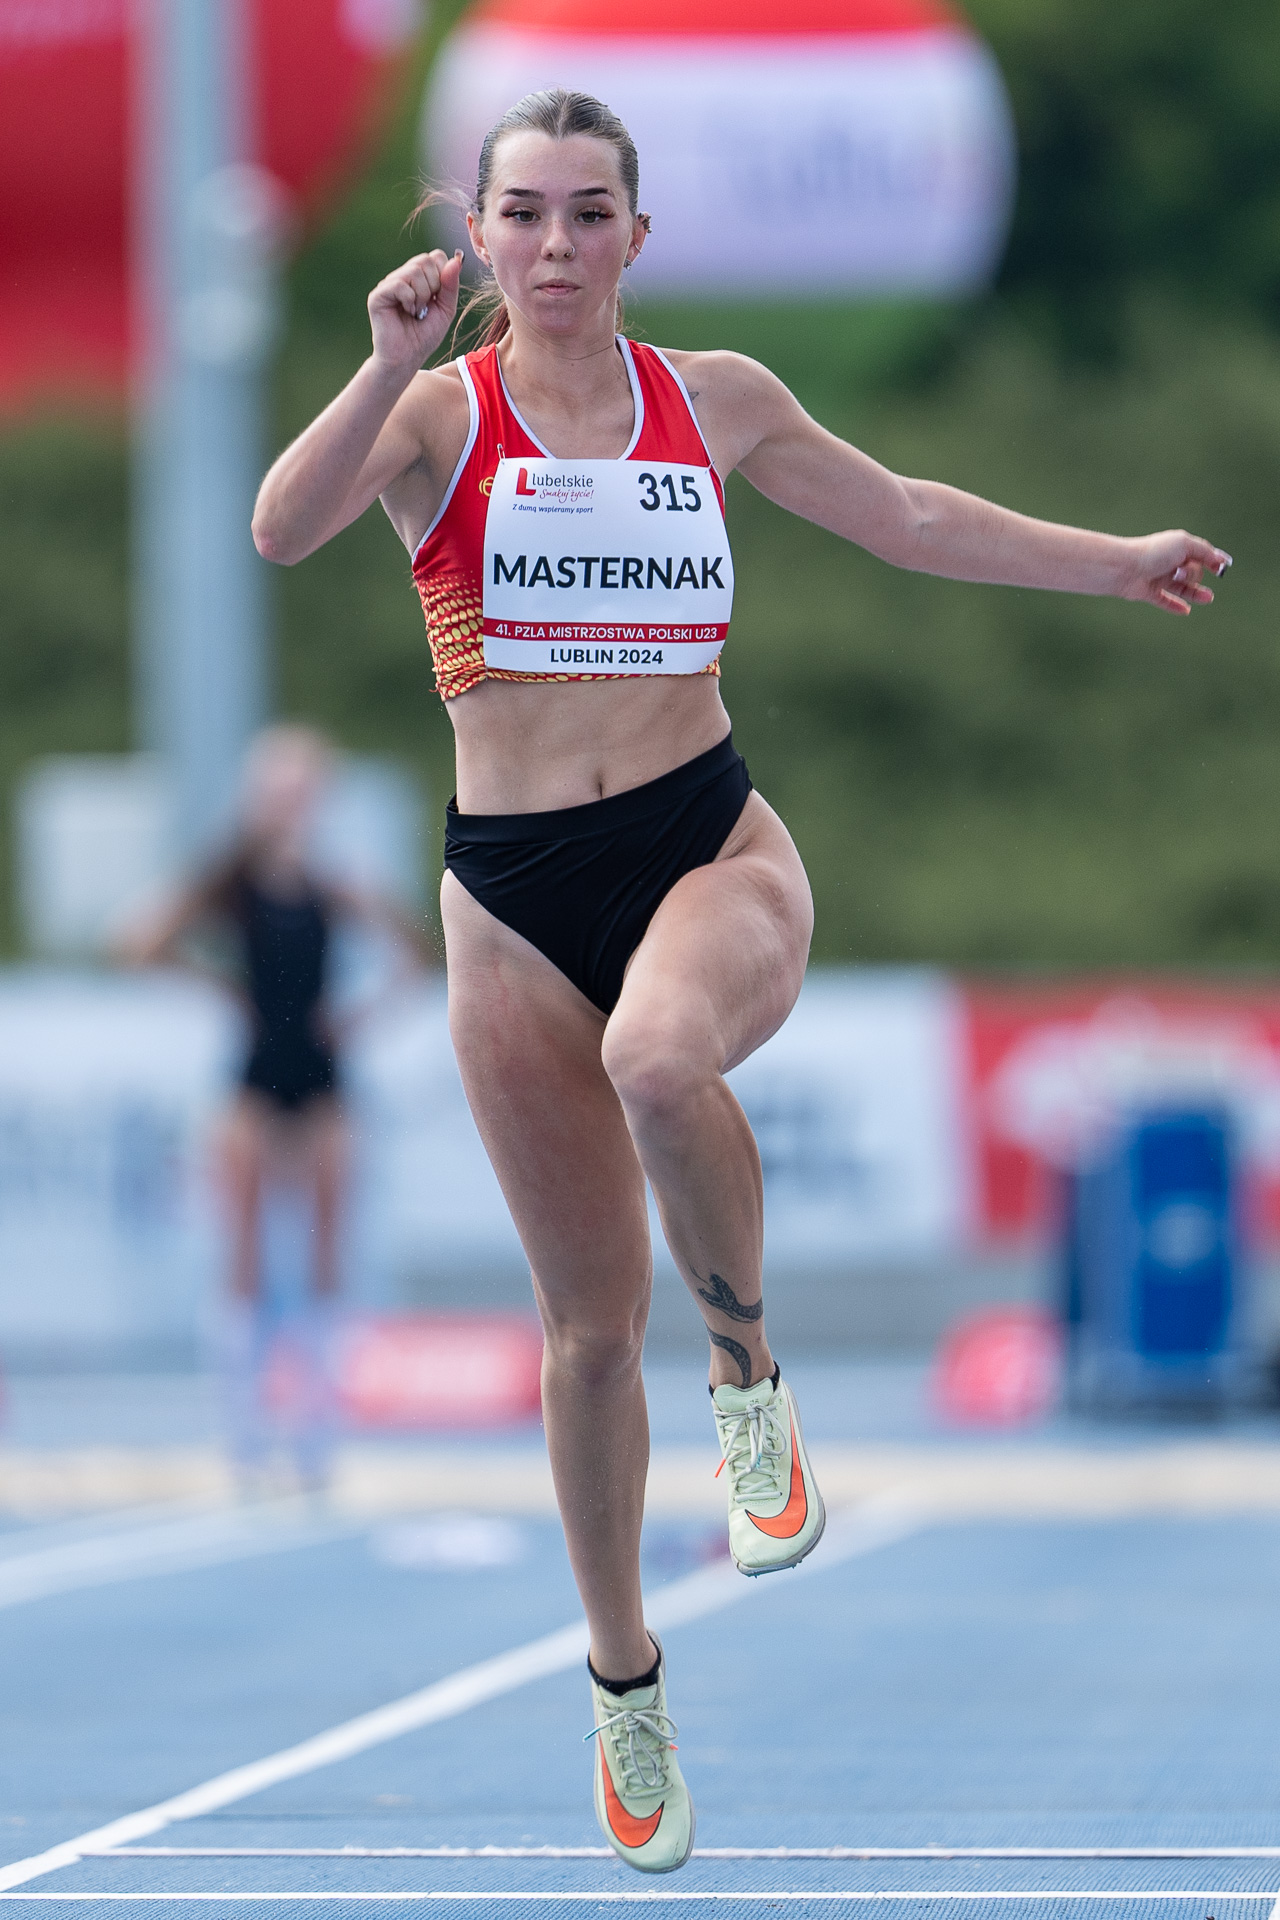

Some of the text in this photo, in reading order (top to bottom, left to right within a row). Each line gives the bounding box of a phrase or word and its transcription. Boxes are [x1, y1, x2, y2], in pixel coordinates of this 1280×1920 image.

[539, 488, 594, 503] Smakuj życie!
[638, 472, 702, 512] 315
[518, 504, 537, 513] dumą
[538, 506, 575, 514] wspieramy
[575, 506, 594, 514] sport
[493, 553, 726, 590] MASTERNAK
[495, 624, 718, 640] 41. PZLA MISTRZOSTWA POLSKI U23
[550, 648, 664, 665] LUBLIN 2024
